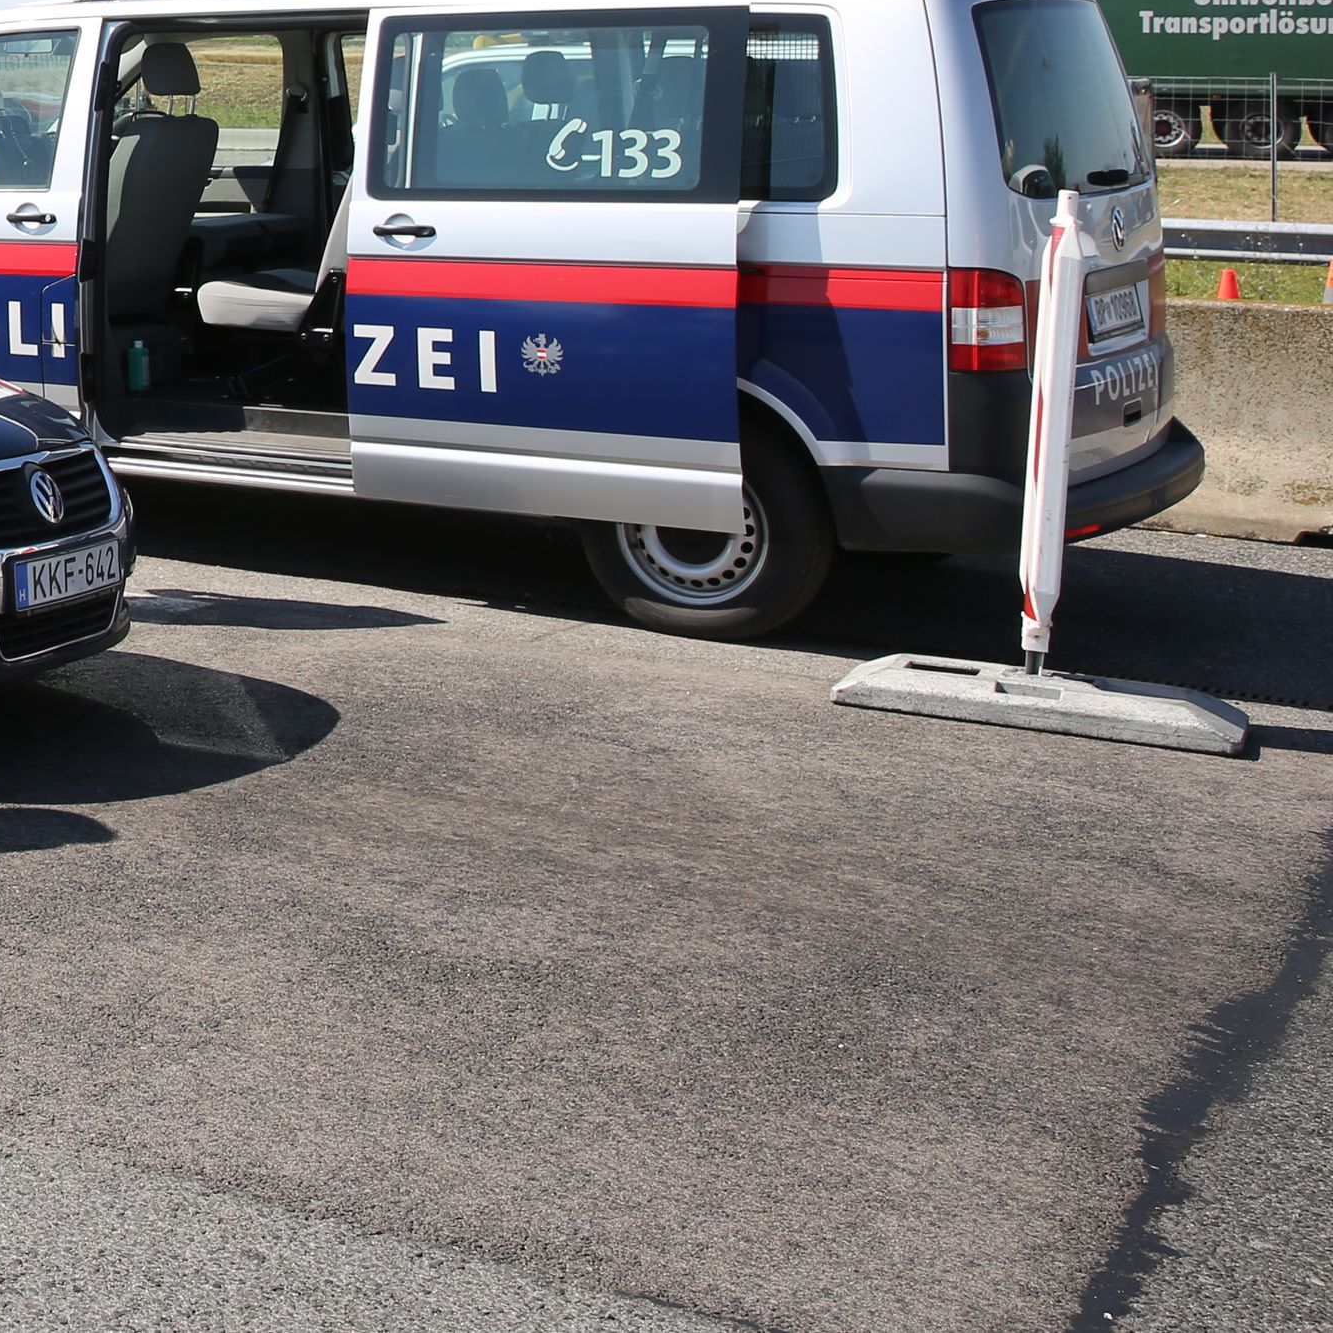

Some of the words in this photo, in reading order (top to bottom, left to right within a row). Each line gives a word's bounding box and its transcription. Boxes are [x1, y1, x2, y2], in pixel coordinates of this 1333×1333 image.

[591, 128, 683, 179] 133
[1090, 350, 1159, 406] POLIZEI
[32, 545, 117, 601] KKF-642
